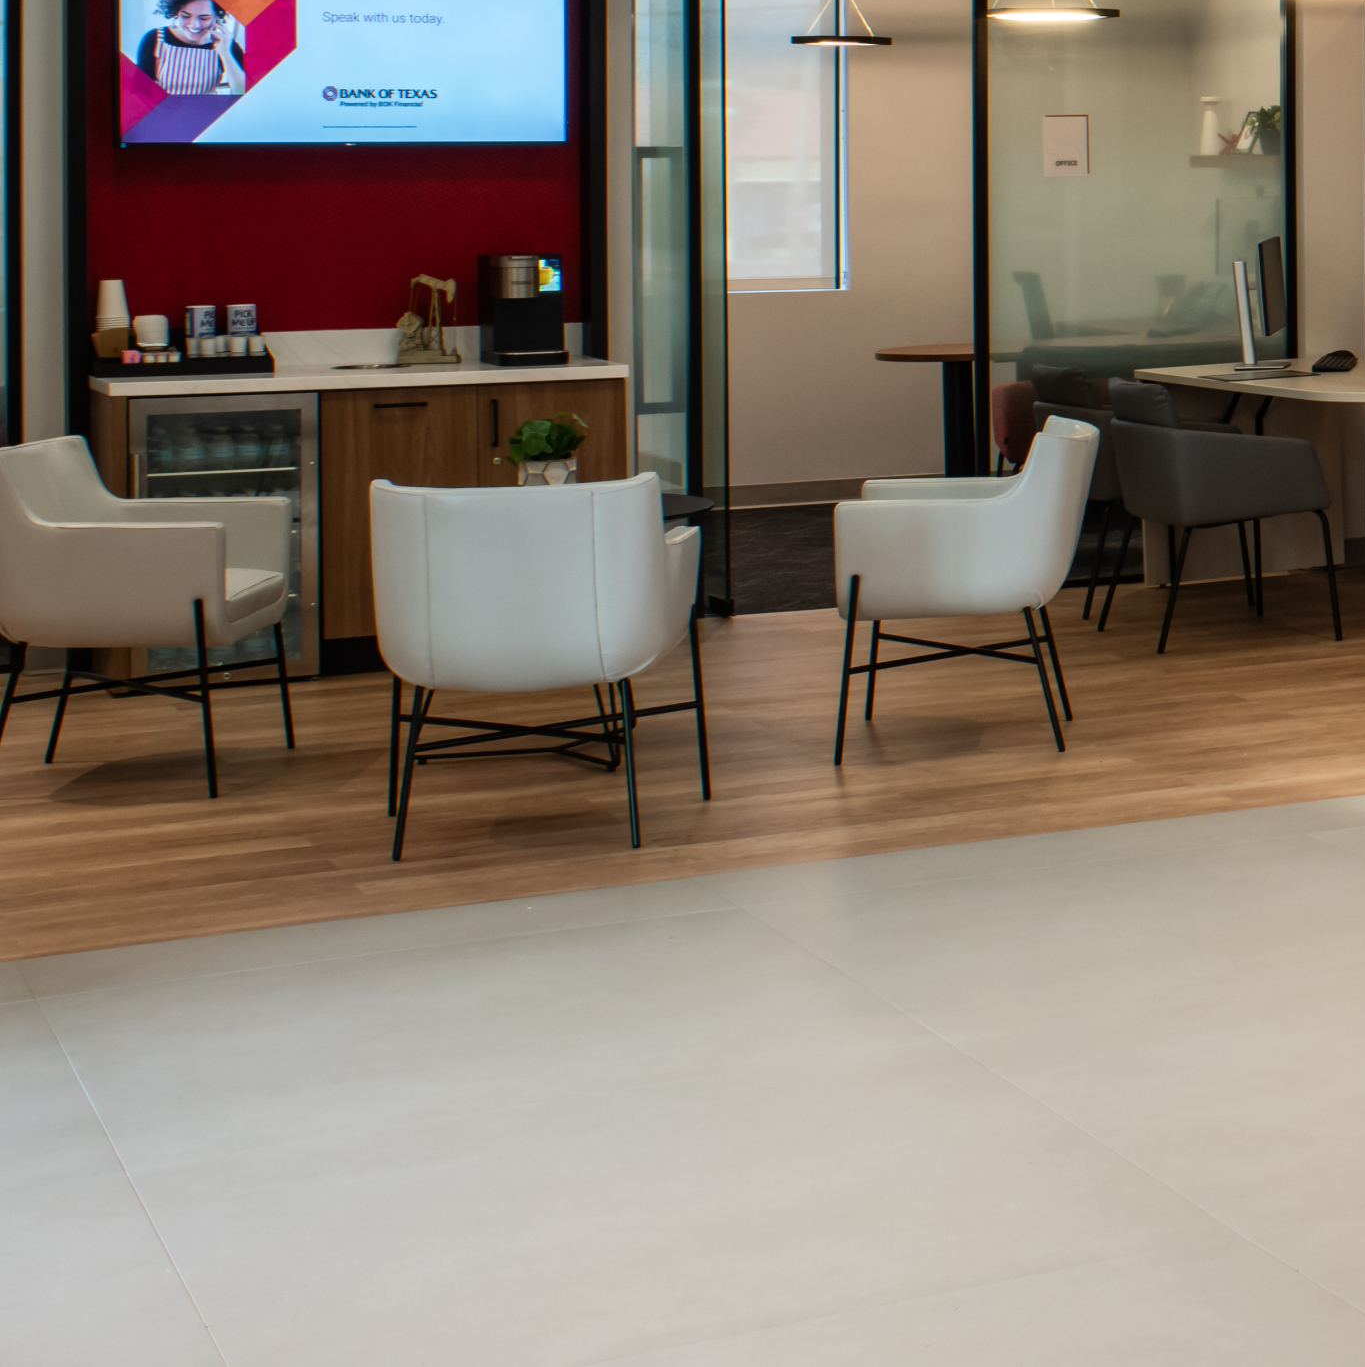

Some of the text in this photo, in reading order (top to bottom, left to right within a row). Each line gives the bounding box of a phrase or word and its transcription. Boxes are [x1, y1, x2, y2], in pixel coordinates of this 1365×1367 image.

[322, 11, 445, 26] Speak with us today.
[340, 89, 438, 99] BANK OF TEXAS
